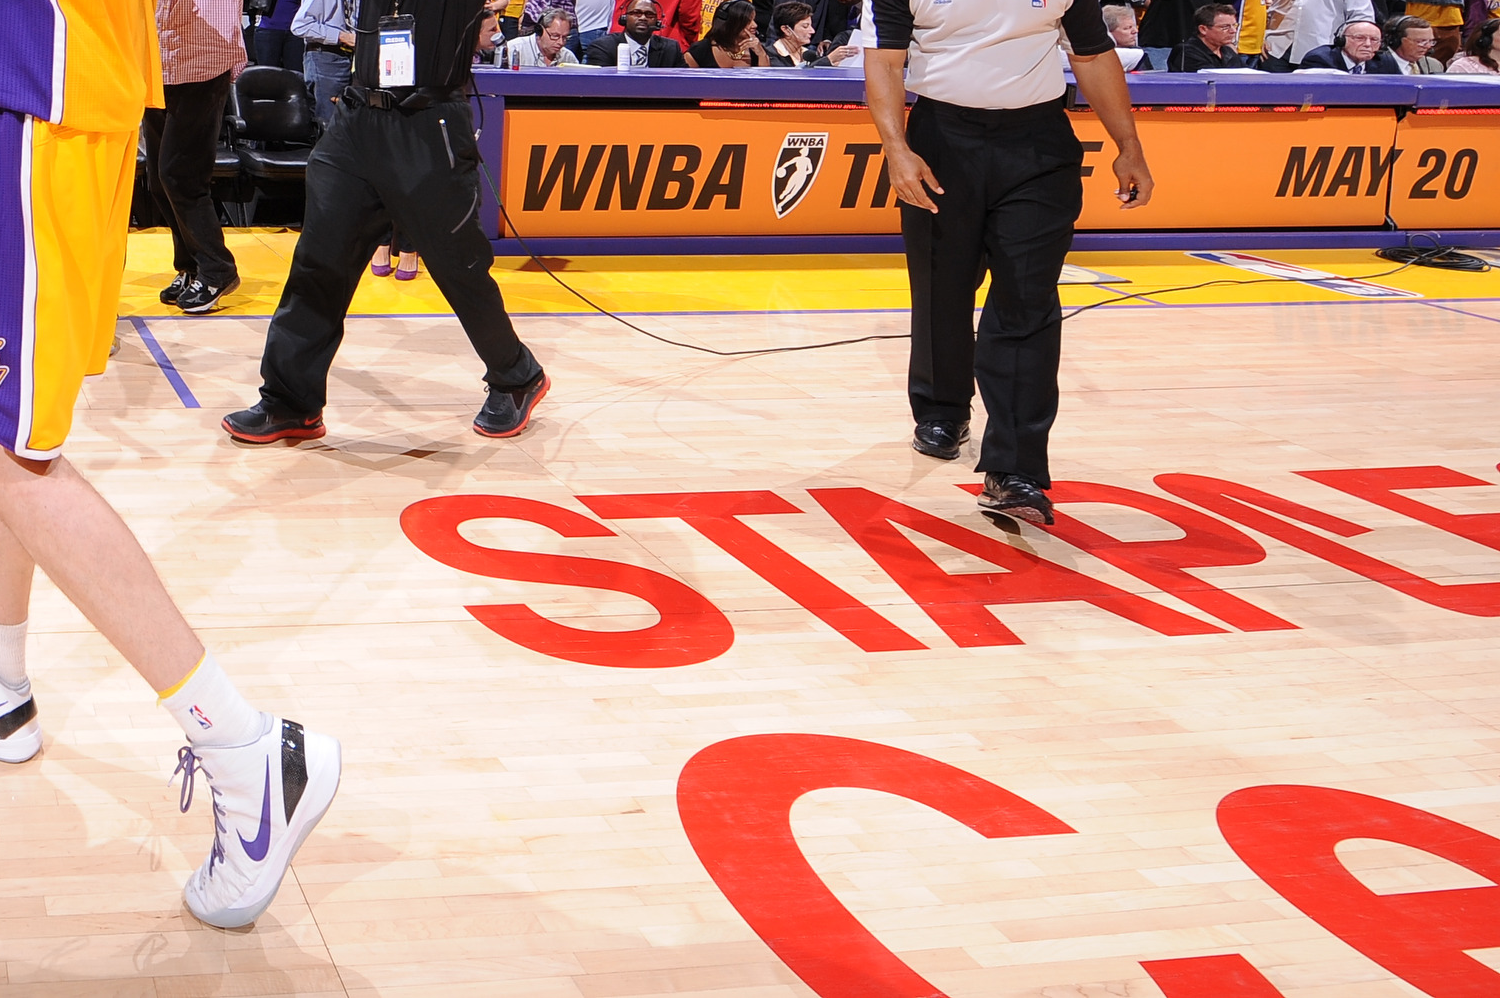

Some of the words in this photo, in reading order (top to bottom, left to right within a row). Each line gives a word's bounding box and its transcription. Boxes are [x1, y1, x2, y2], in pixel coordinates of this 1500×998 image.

[787, 138, 824, 147] WNBA
[1274, 146, 1404, 198] MAY
[1408, 148, 1479, 200] 20
[521, 144, 749, 212] WNBA
[399, 464, 1500, 669] STAPLE
